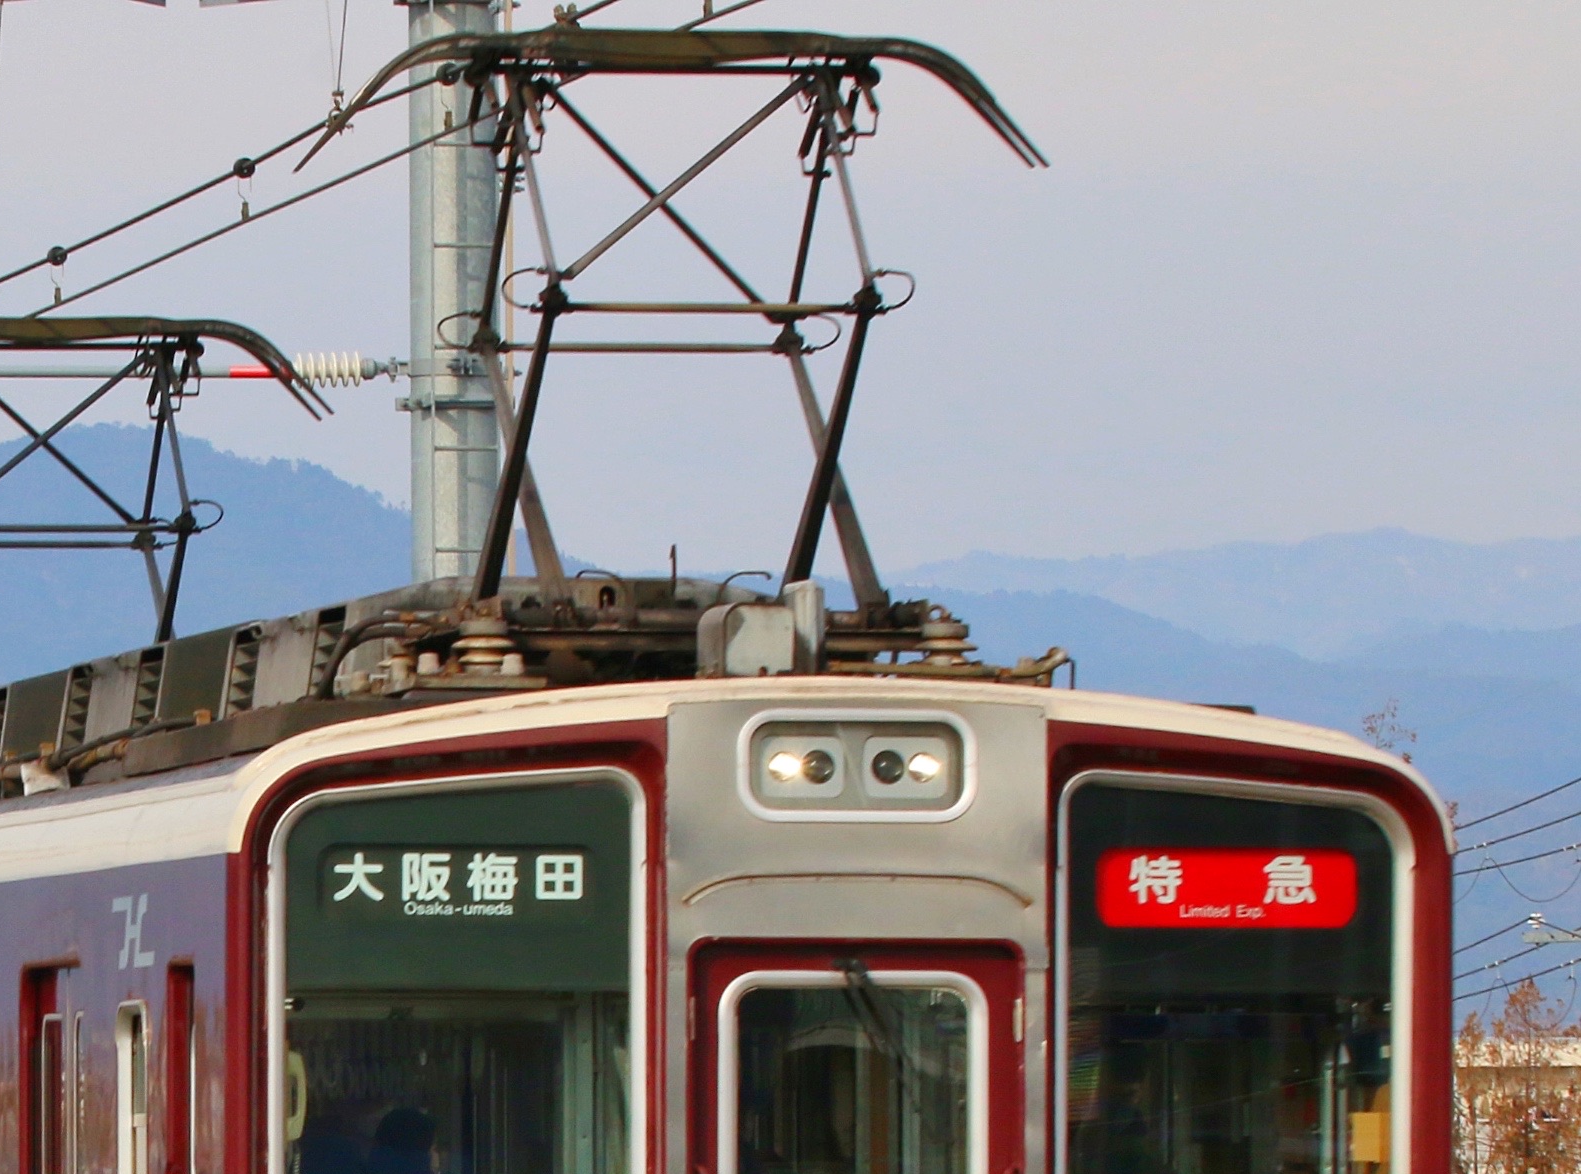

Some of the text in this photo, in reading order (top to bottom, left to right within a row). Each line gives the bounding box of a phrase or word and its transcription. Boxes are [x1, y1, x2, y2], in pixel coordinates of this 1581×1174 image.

[333, 853, 584, 901] 大阪梅田
[1128, 854, 1317, 904] 特急
[403, 901, 514, 916] Osaka-umeda
[1179, 904, 1267, 919] Limited Exp.
